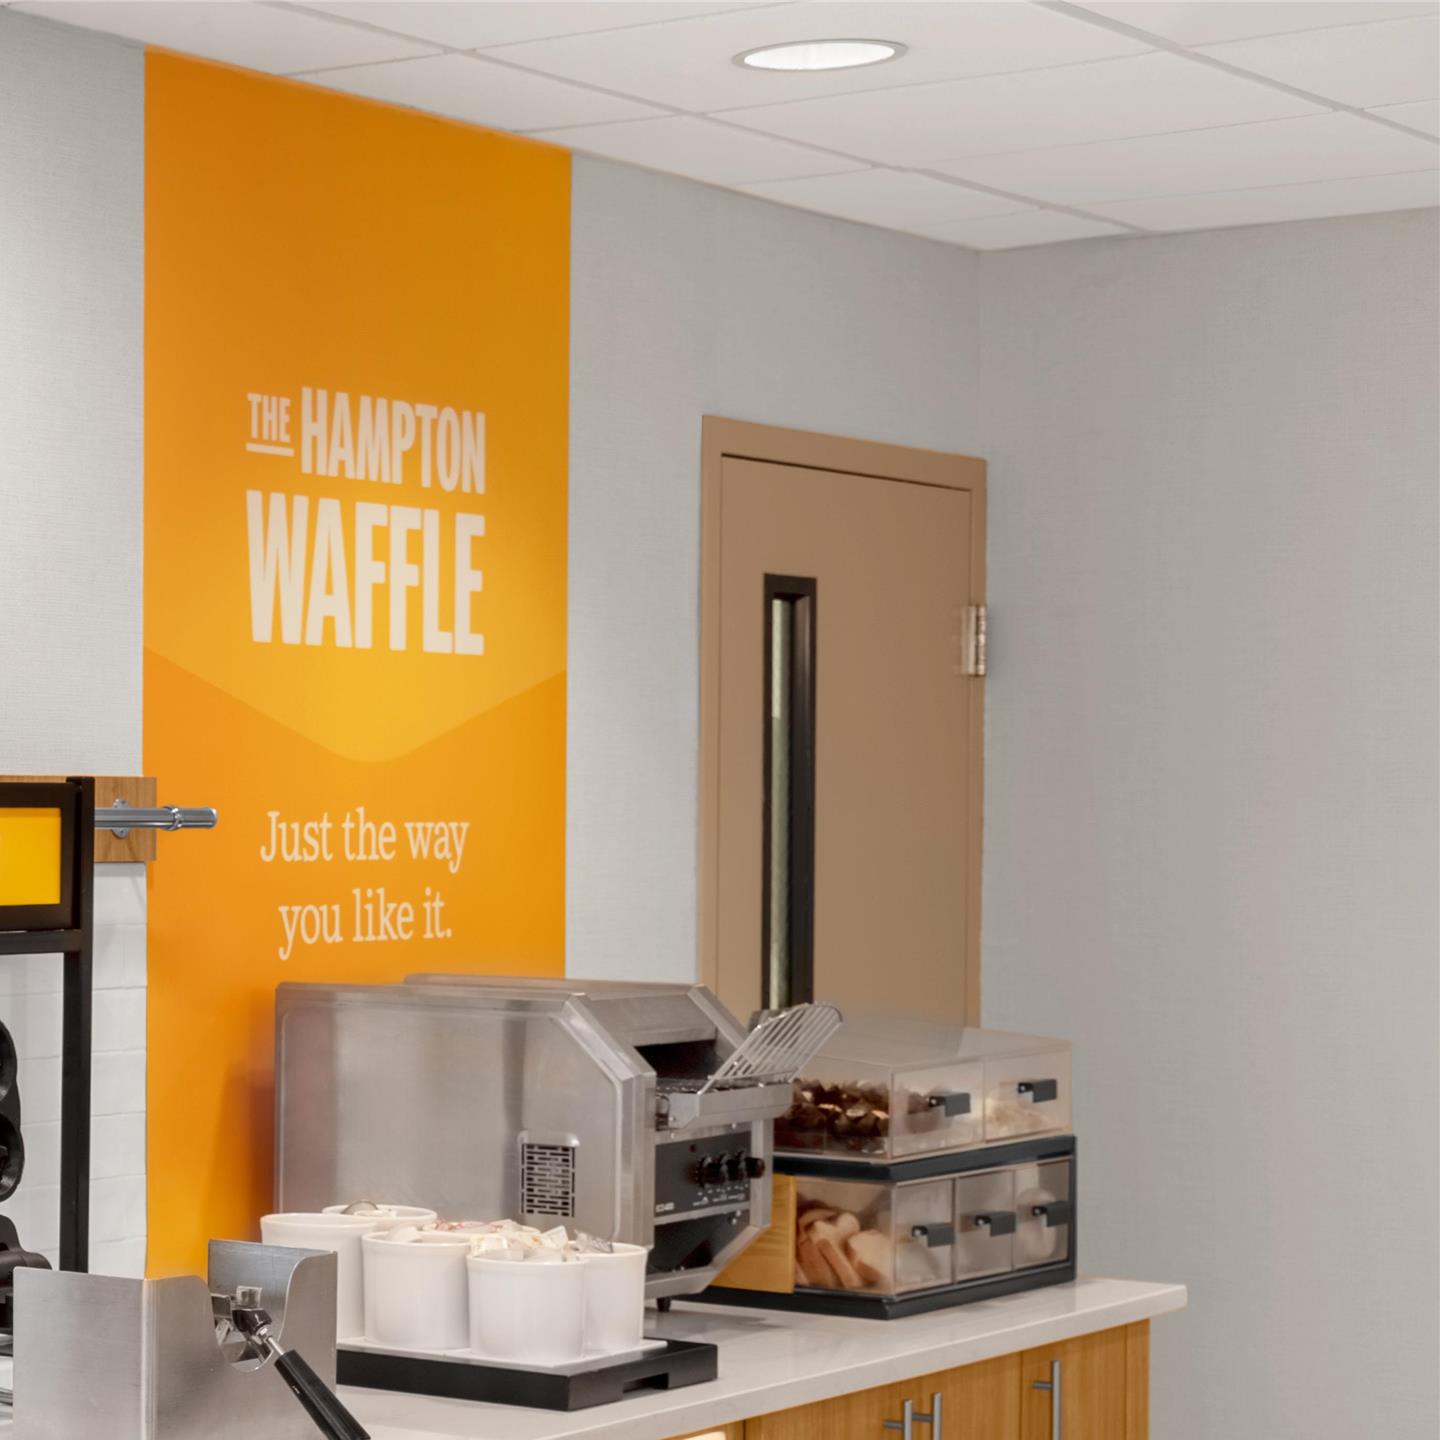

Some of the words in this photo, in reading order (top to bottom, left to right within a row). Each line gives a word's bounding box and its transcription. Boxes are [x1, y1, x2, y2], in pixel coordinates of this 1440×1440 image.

[246, 392, 292, 444] THE
[300, 386, 487, 495] HAMPTON
[245, 489, 486, 656] WAFFLE
[260, 809, 333, 864] Just
[342, 806, 397, 861] the
[404, 820, 470, 874] way
[278, 902, 341, 961] you
[352, 888, 415, 943] like
[423, 887, 452, 940] it.
